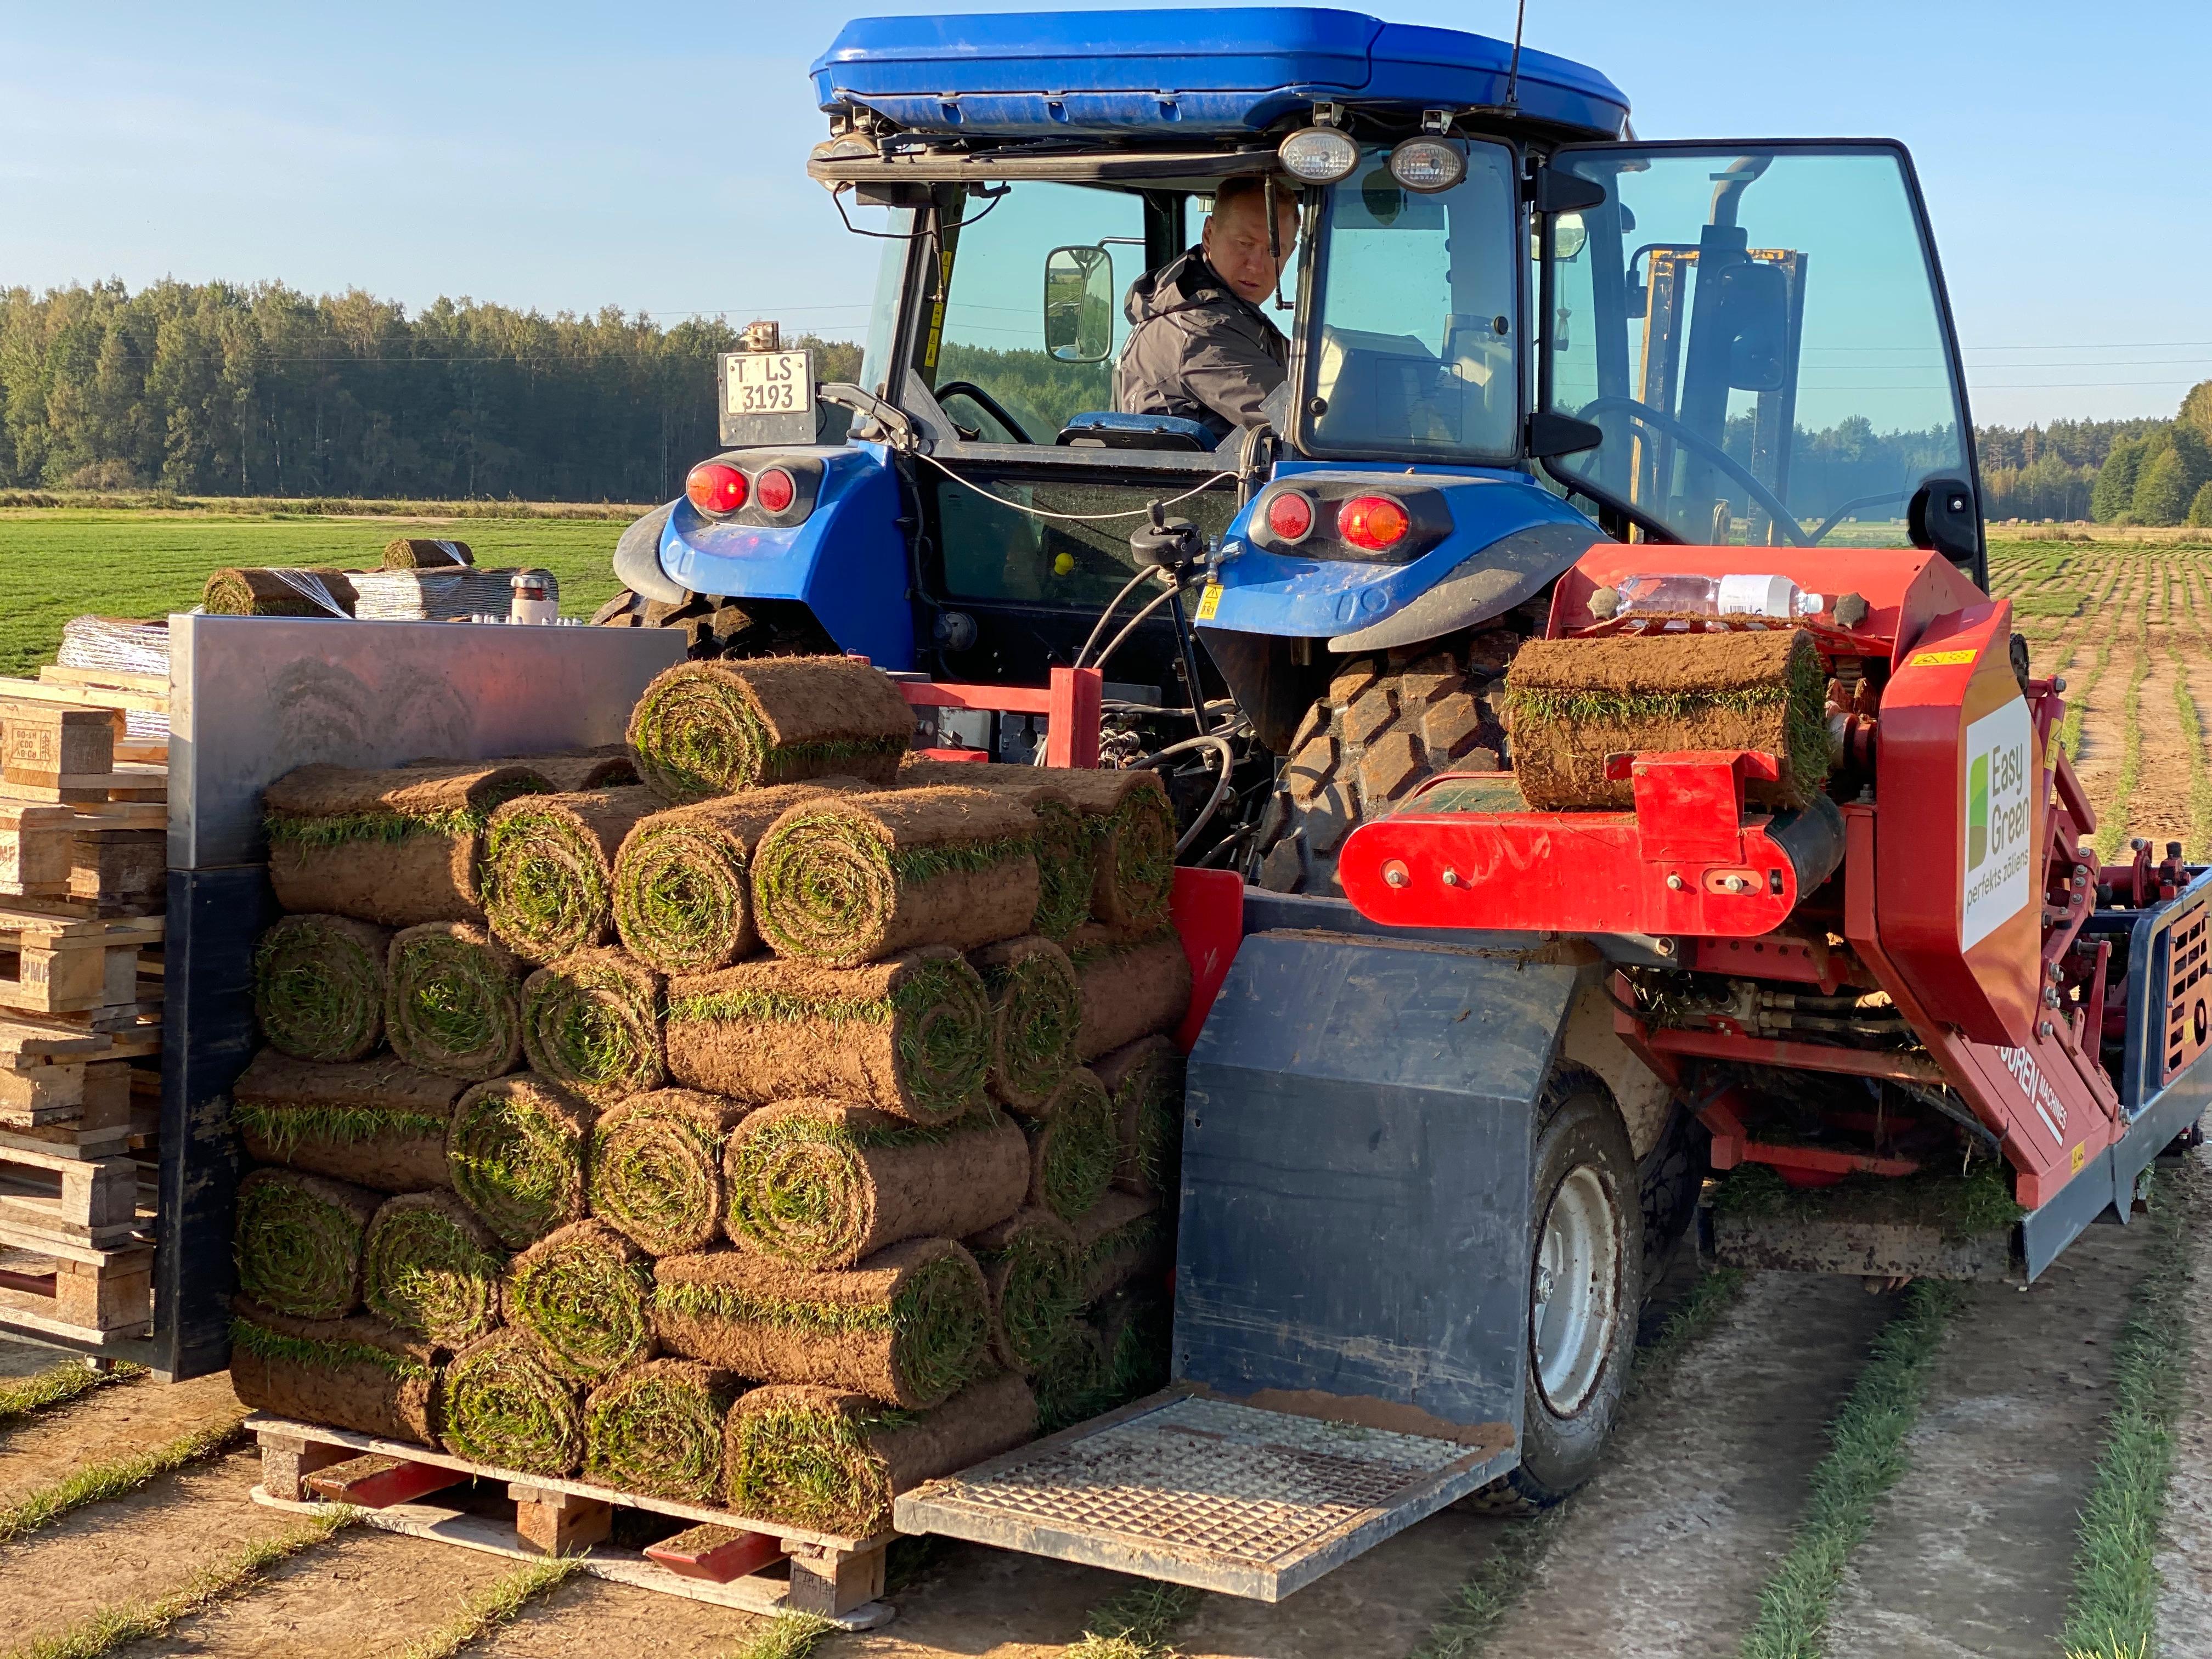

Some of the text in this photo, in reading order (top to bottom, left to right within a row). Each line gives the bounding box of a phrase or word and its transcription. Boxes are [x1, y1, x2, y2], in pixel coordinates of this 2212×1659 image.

[734, 356, 792, 382] T LS
[742, 383, 793, 410] 3193
[1992, 743, 2023, 798] Easy
[1991, 797, 2029, 855] Green
[1967, 849, 2028, 915] perfekts zāliens
[2039, 1074, 2068, 1130] MACHINES
